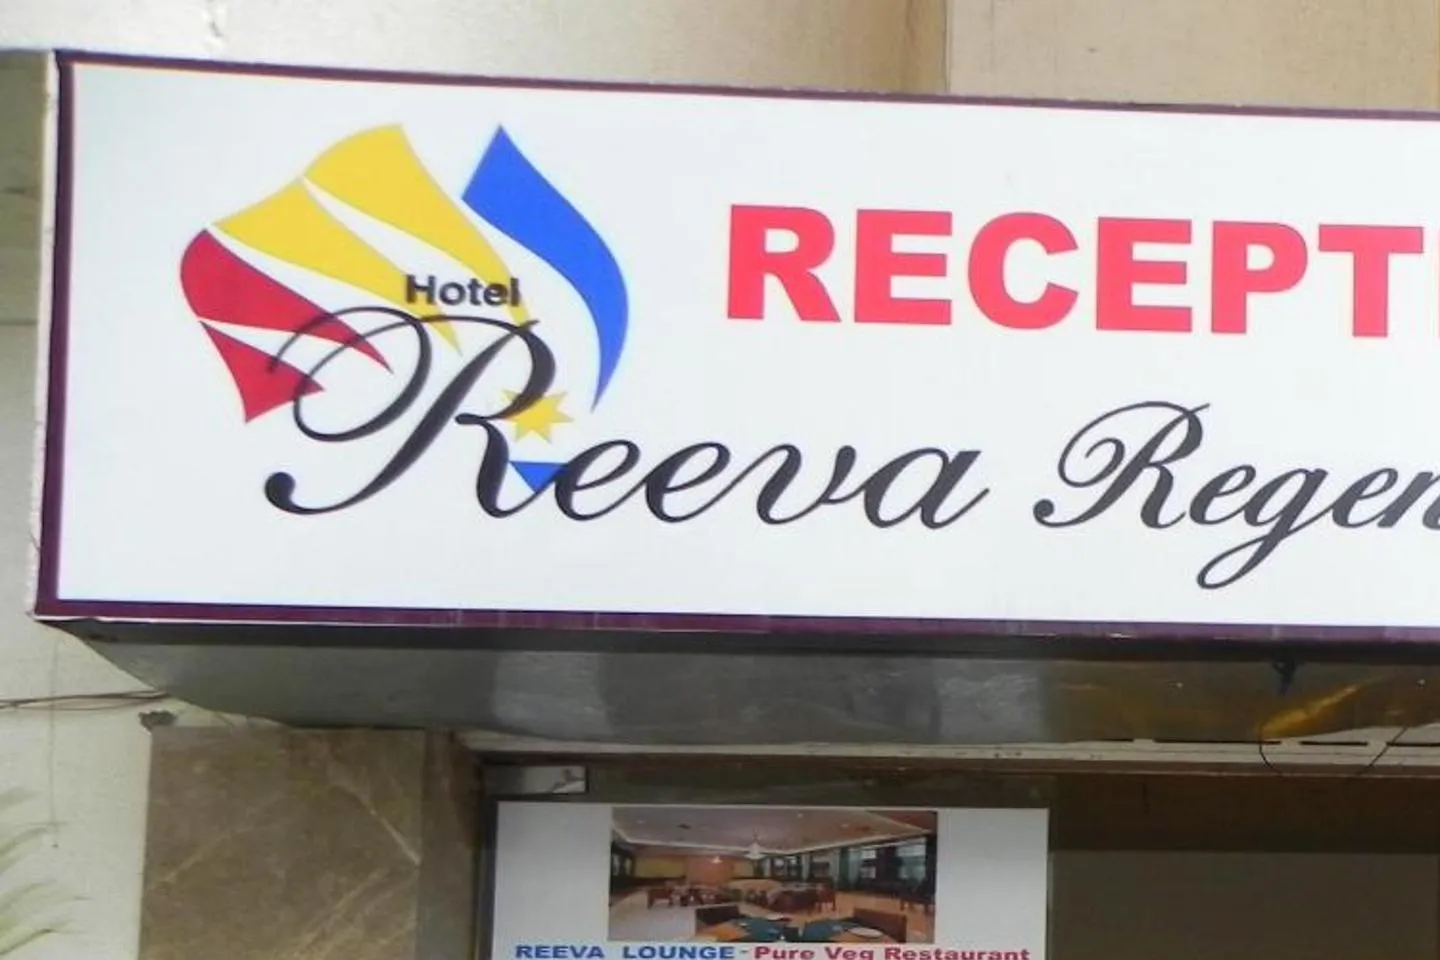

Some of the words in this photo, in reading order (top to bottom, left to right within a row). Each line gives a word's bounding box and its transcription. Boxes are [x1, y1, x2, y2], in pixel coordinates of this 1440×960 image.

[406, 275, 520, 307] Hotel
[264, 305, 990, 529] Reeva
[514, 945, 605, 959] REEVA
[622, 945, 735, 960] LOUNGE
[753, 945, 815, 960] Pure
